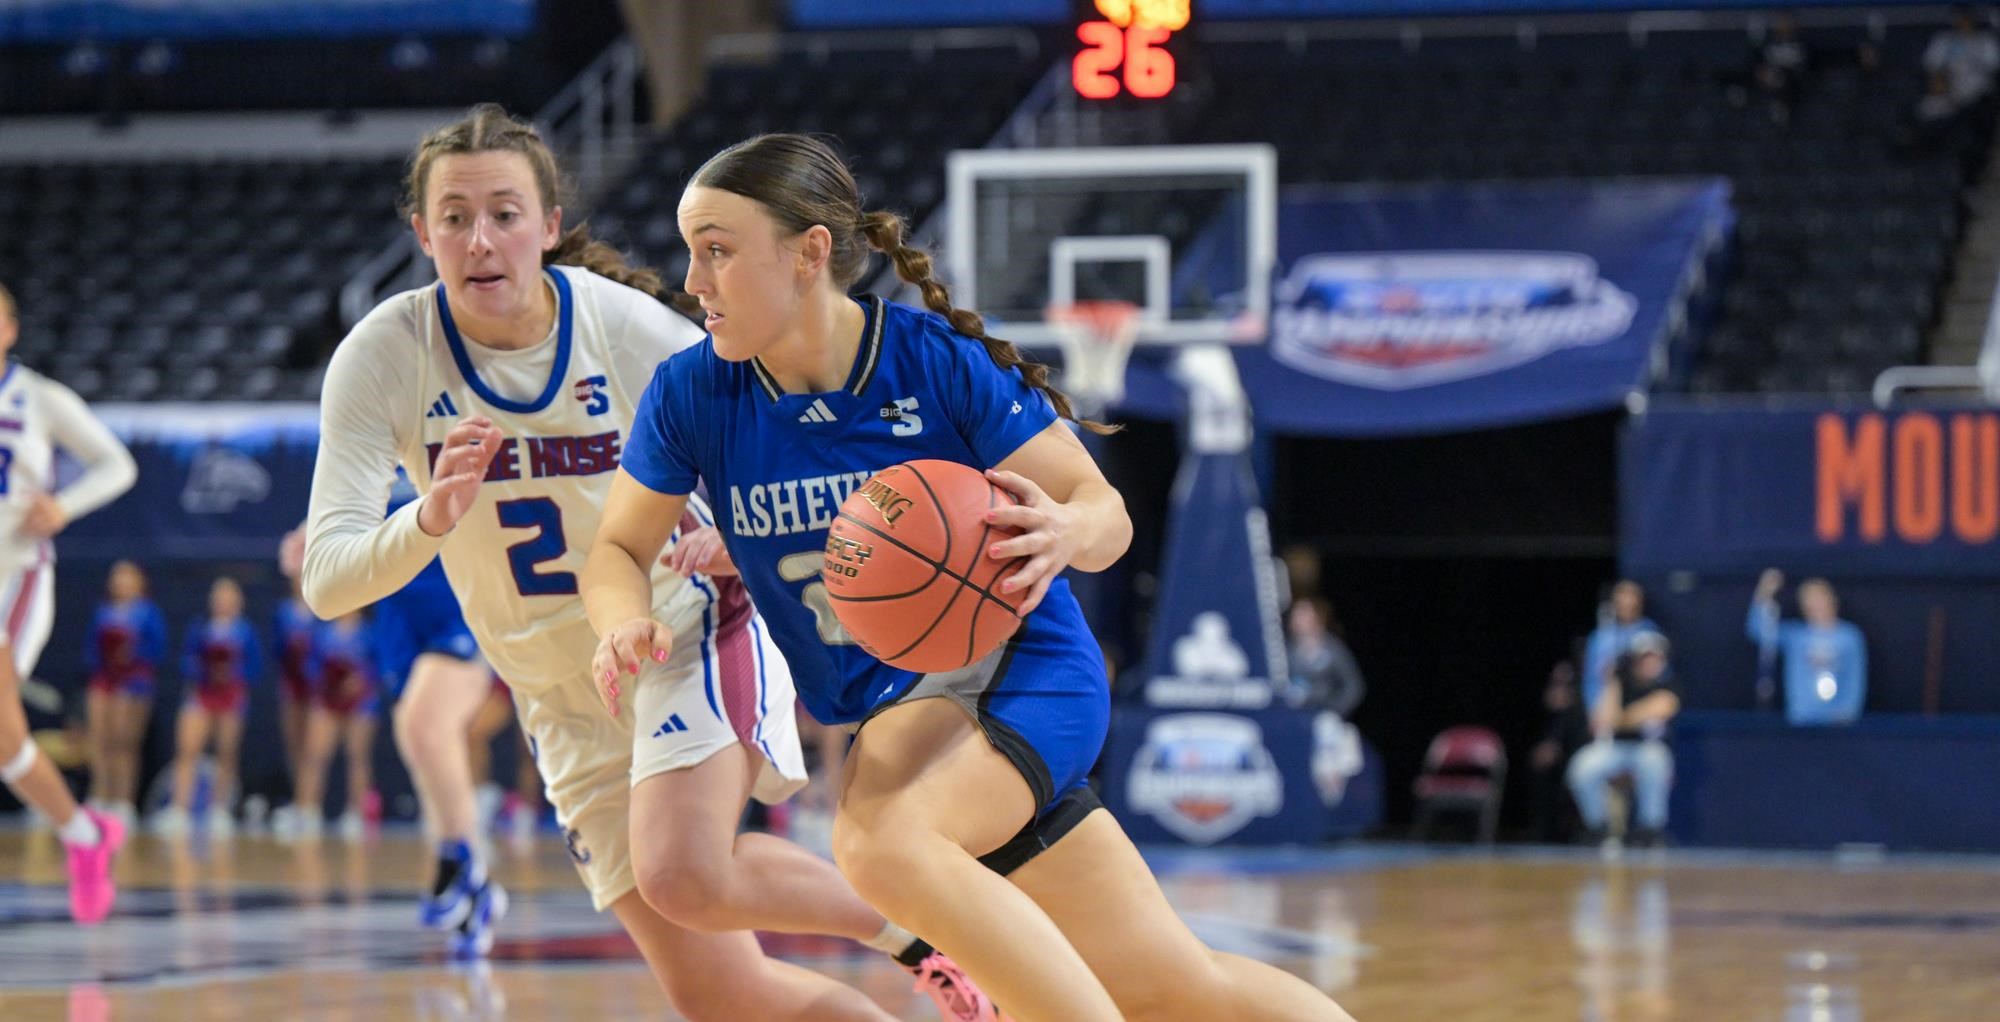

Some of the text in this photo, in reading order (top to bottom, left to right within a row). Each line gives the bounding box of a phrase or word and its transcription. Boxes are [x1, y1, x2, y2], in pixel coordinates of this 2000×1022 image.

[1072, 20, 1176, 99] 26
[880, 396, 923, 436] BIG S
[524, 430, 622, 479] HOSE
[1816, 411, 1998, 545] MOU
[730, 470, 881, 537] ASHEV
[859, 479, 913, 527] DING
[497, 496, 579, 597] 2
